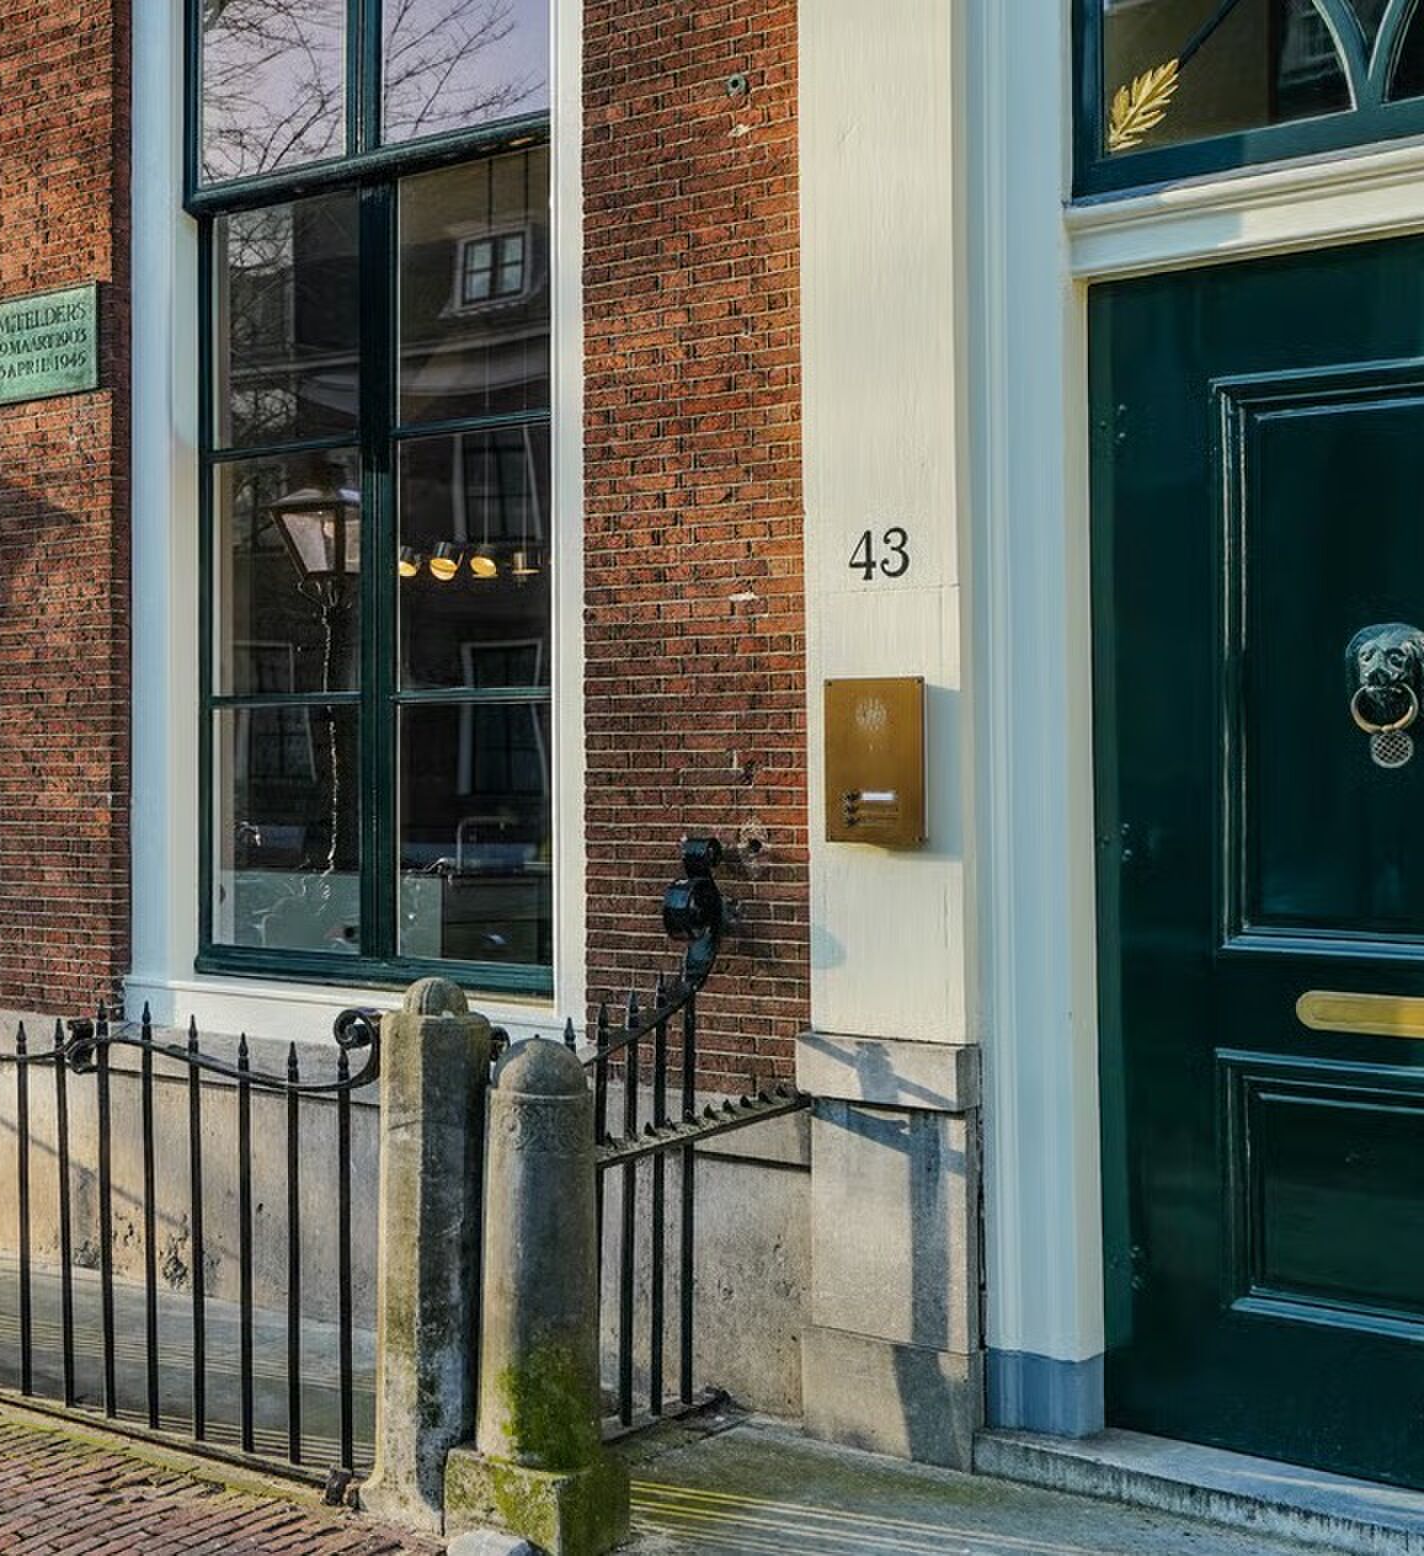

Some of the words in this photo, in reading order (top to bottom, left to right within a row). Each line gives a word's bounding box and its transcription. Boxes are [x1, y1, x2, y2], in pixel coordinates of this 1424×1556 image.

[9, 335, 54, 354] MAART
[56, 328, 87, 347] 1903
[7, 358, 50, 379] APRIL
[54, 350, 87, 371] 1945
[849, 527, 910, 580] 43
